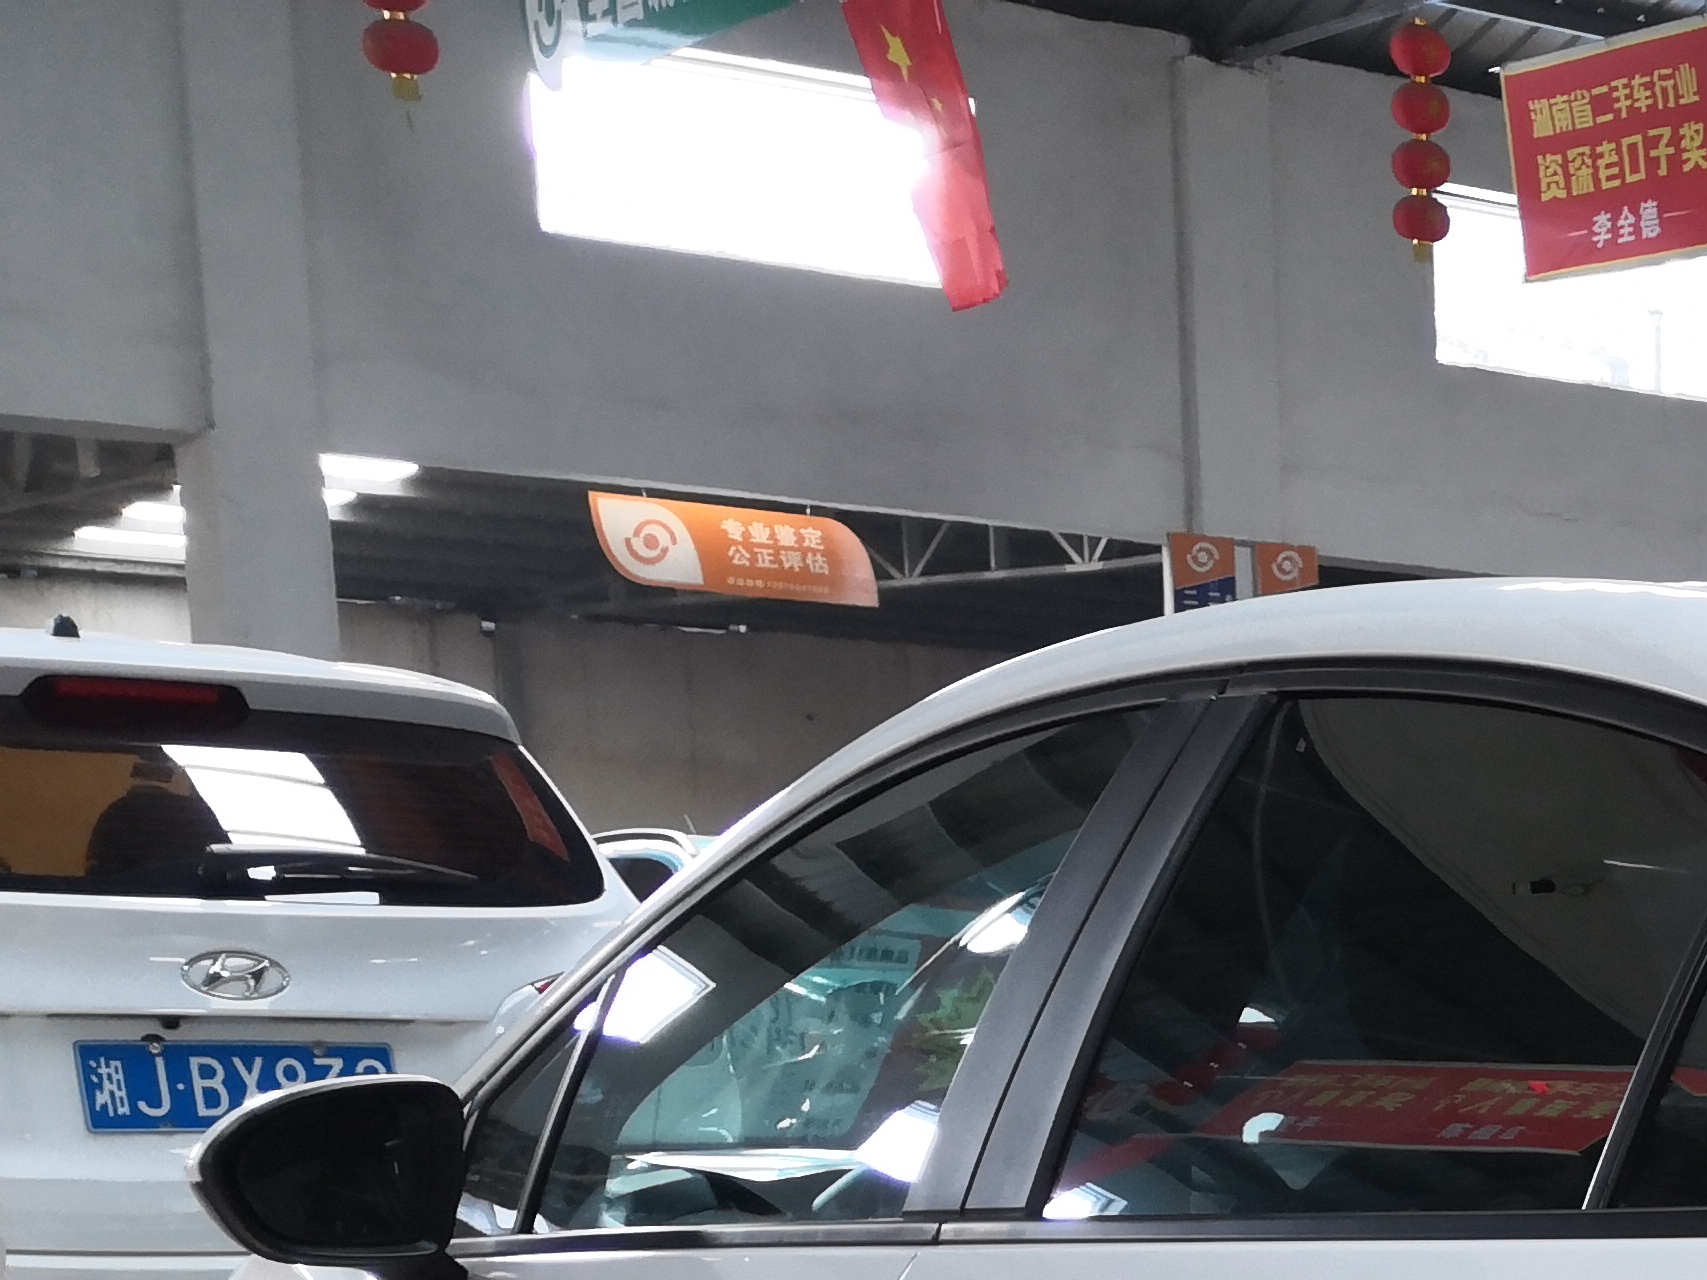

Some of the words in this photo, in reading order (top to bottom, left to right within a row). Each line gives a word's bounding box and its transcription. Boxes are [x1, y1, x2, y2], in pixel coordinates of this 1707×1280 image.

[1528, 62, 1701, 138] 湖南省二手车行业
[720, 518, 825, 550] 专业鉴定
[727, 545, 829, 575] 公正评估
[88, 1055, 388, 1117] 湘J·BX
